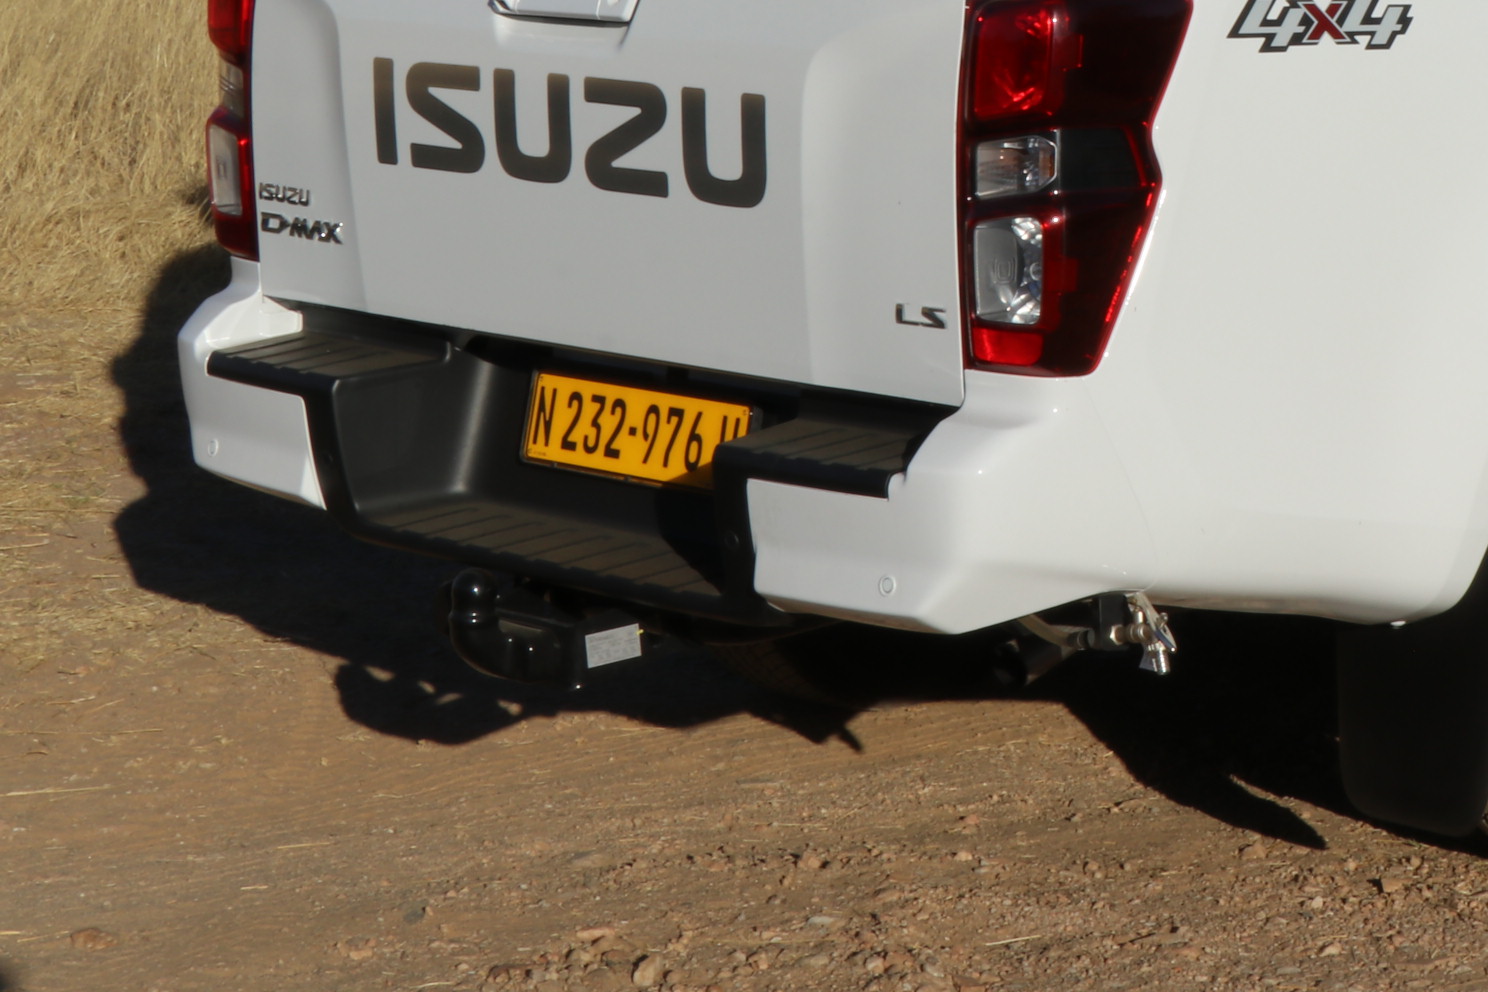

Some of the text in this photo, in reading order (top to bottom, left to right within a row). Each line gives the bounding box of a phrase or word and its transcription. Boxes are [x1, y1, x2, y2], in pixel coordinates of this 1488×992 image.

[373, 56, 767, 209] ISUZU
[259, 182, 310, 206] ISUZU
[895, 303, 947, 329] LS
